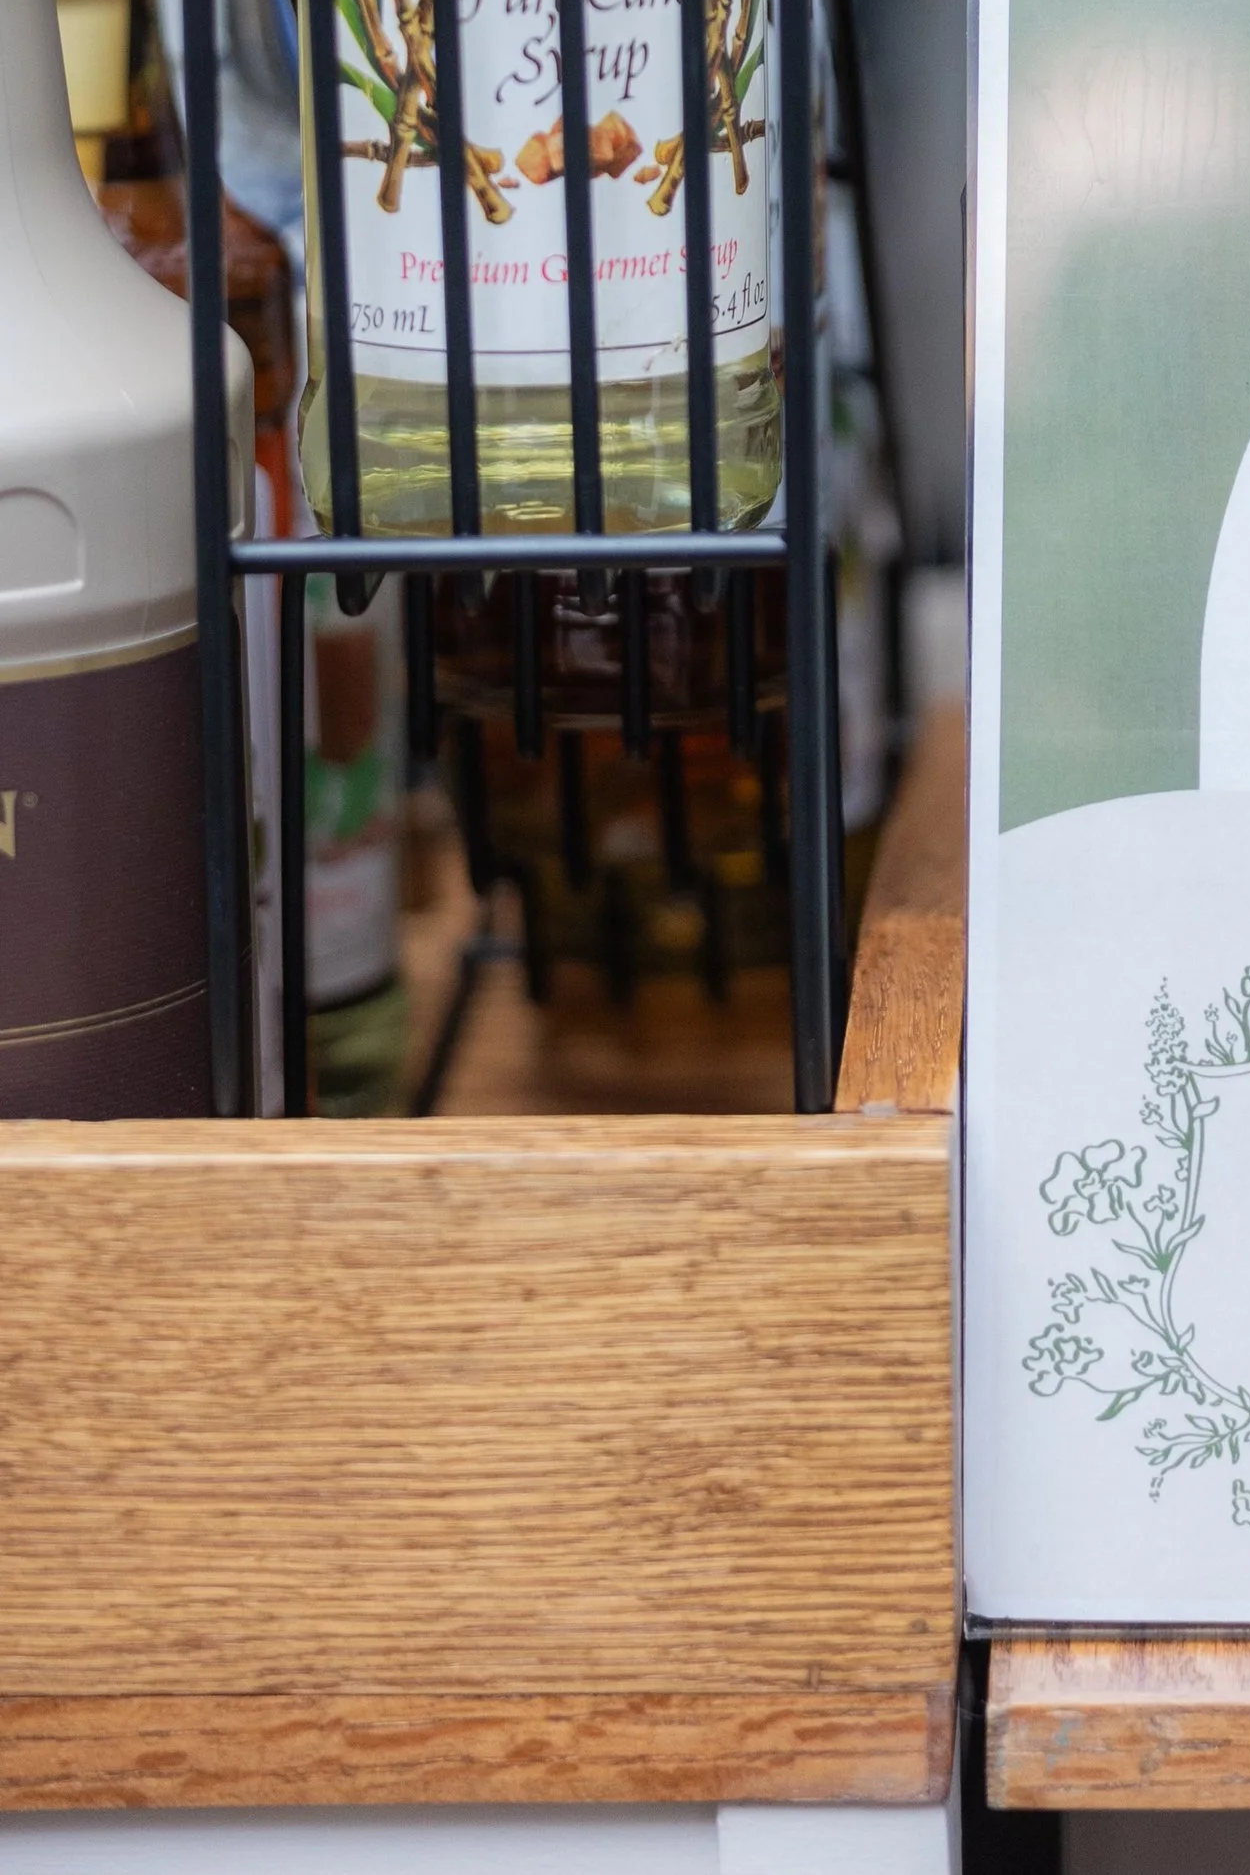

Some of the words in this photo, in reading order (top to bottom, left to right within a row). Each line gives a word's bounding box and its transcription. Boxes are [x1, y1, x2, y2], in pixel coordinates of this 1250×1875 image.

[399, 251, 530, 285] Preium
[711, 293, 738, 325] 5.4
[736, 271, 751, 325] fl
[351, 301, 385, 333] 750
[392, 304, 436, 333] mL
